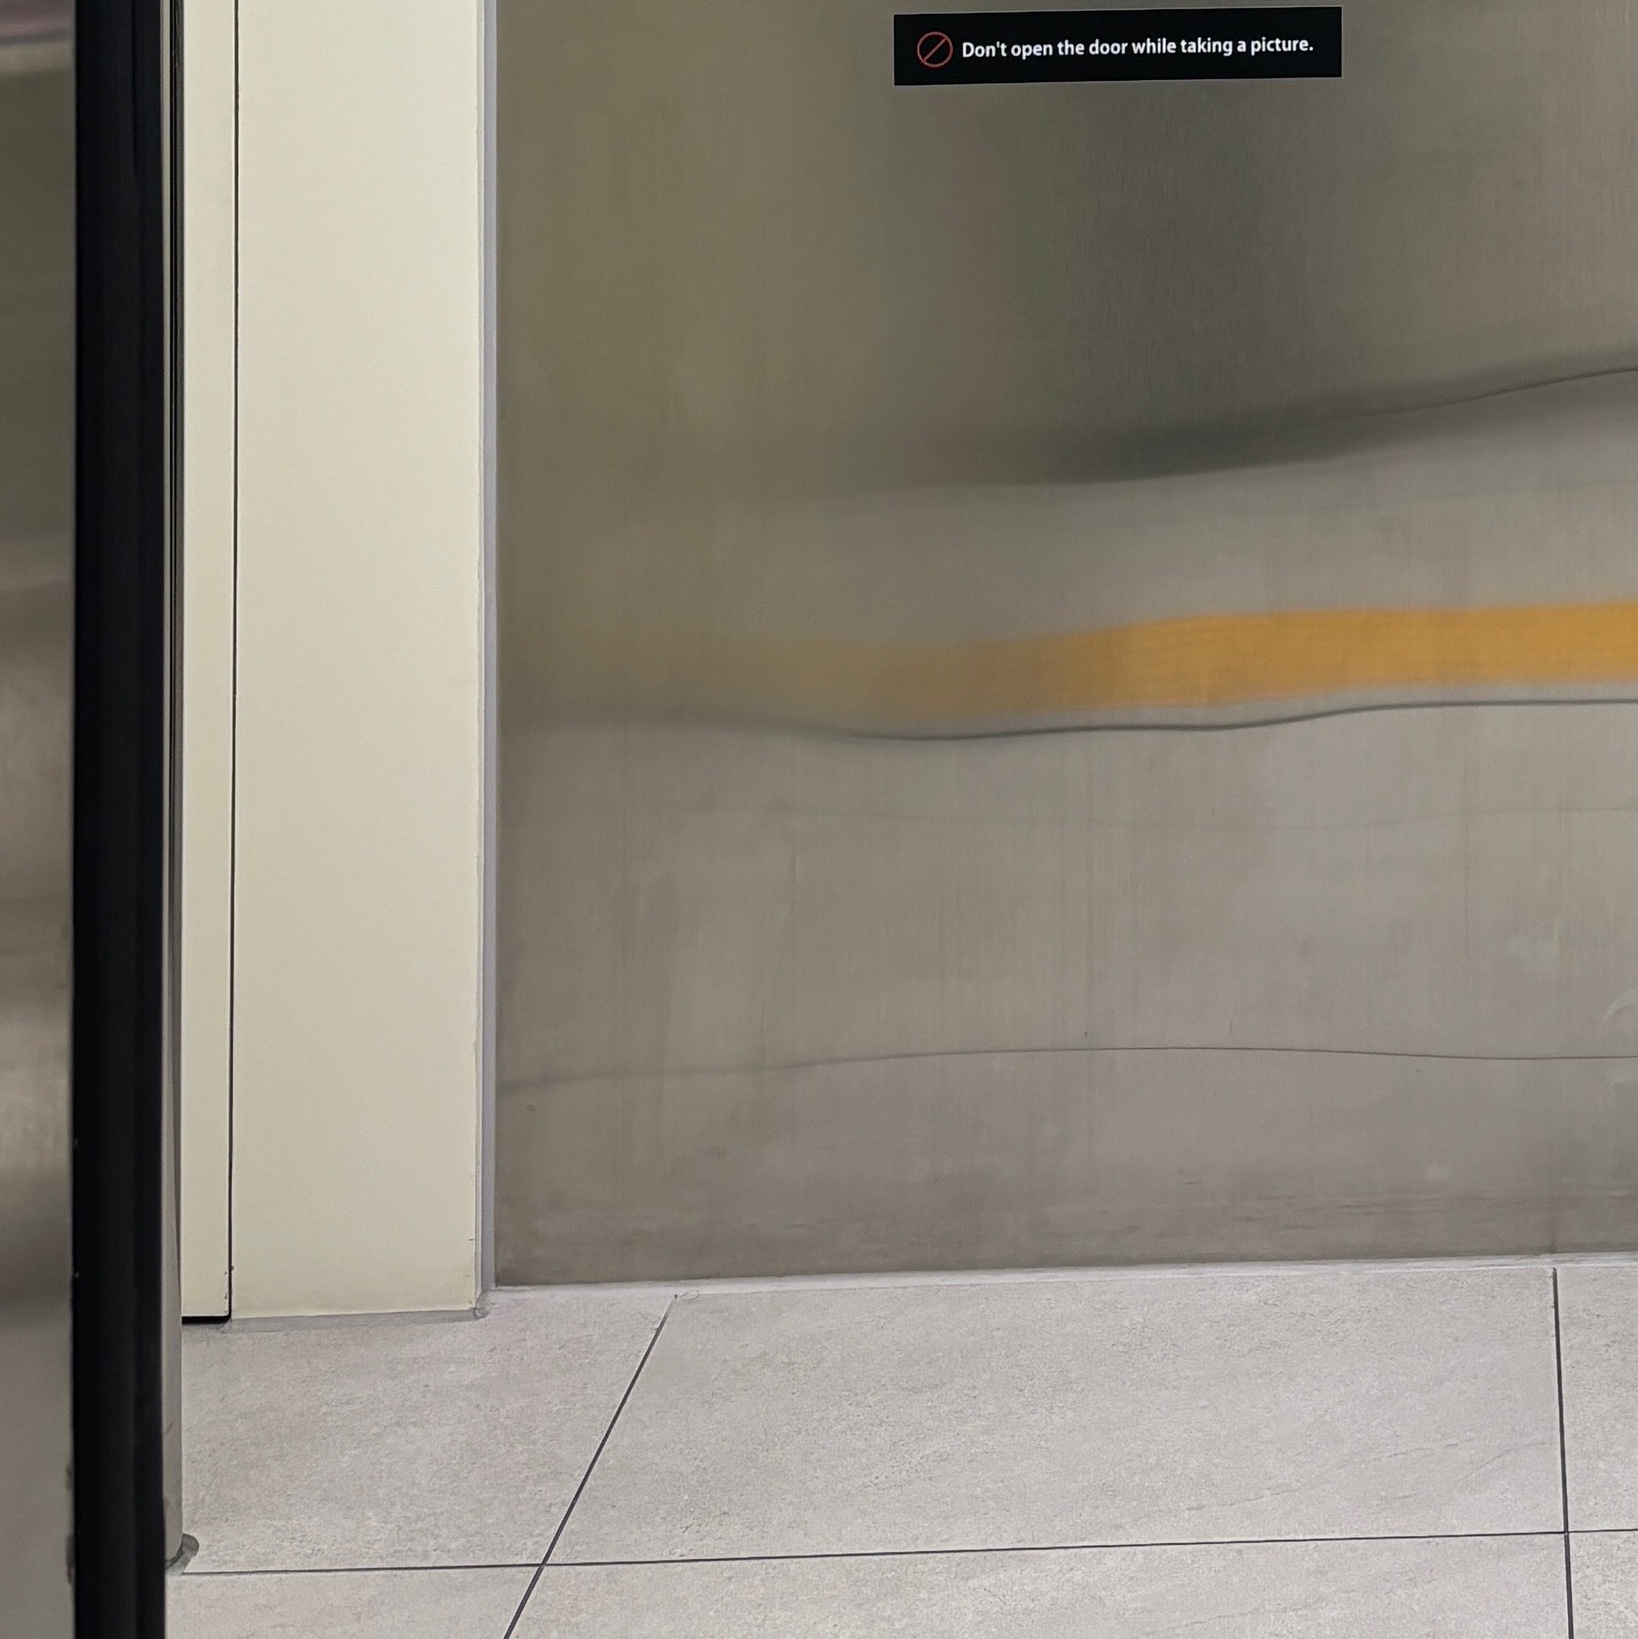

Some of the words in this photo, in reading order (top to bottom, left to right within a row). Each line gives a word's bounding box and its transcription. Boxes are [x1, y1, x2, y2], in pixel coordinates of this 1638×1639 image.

[962, 41, 1008, 58] Don't
[1011, 44, 1053, 60] open
[1057, 39, 1085, 56] the
[1089, 38, 1129, 55] door
[1132, 37, 1177, 54] while
[1181, 36, 1233, 57] taking
[1236, 40, 1247, 53] a
[1250, 36, 1314, 56] picture.
